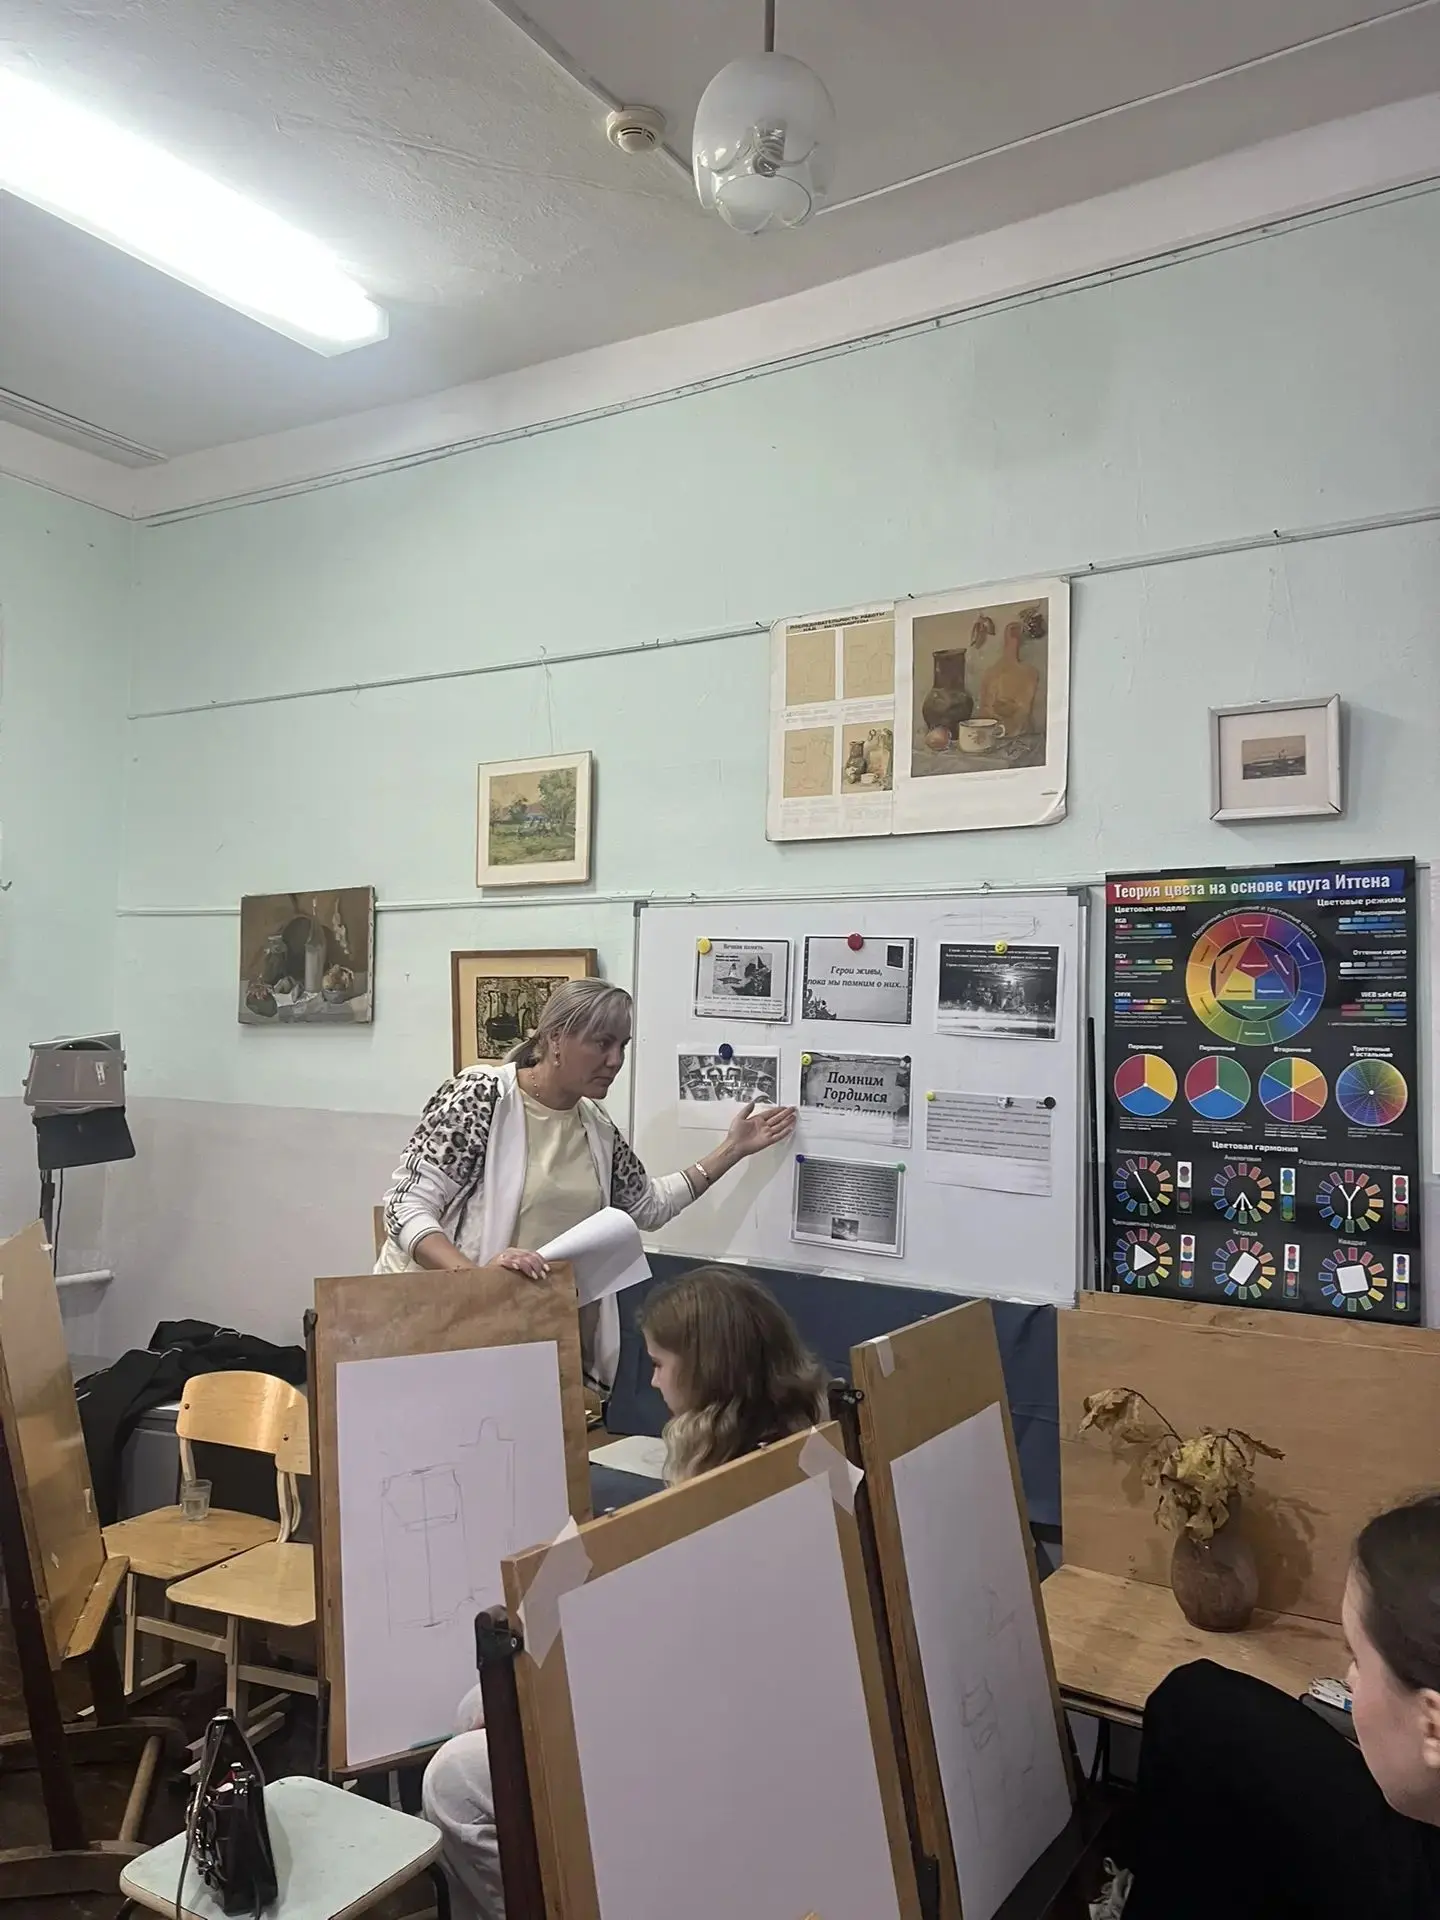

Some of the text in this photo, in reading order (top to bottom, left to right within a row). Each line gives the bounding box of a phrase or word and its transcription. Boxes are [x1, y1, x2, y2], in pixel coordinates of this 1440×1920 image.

[1114, 874, 1390, 900] Теория цвета на основе круга Иттена
[1365, 897, 1406, 905] режимы
[1114, 904, 1185, 914] Цветовые модели
[830, 966, 883, 977] Герои живы,
[827, 1071, 884, 1086] Помним
[823, 1087, 888, 1103] Гордимся
[1212, 1141, 1299, 1152] Цветовая гармония
